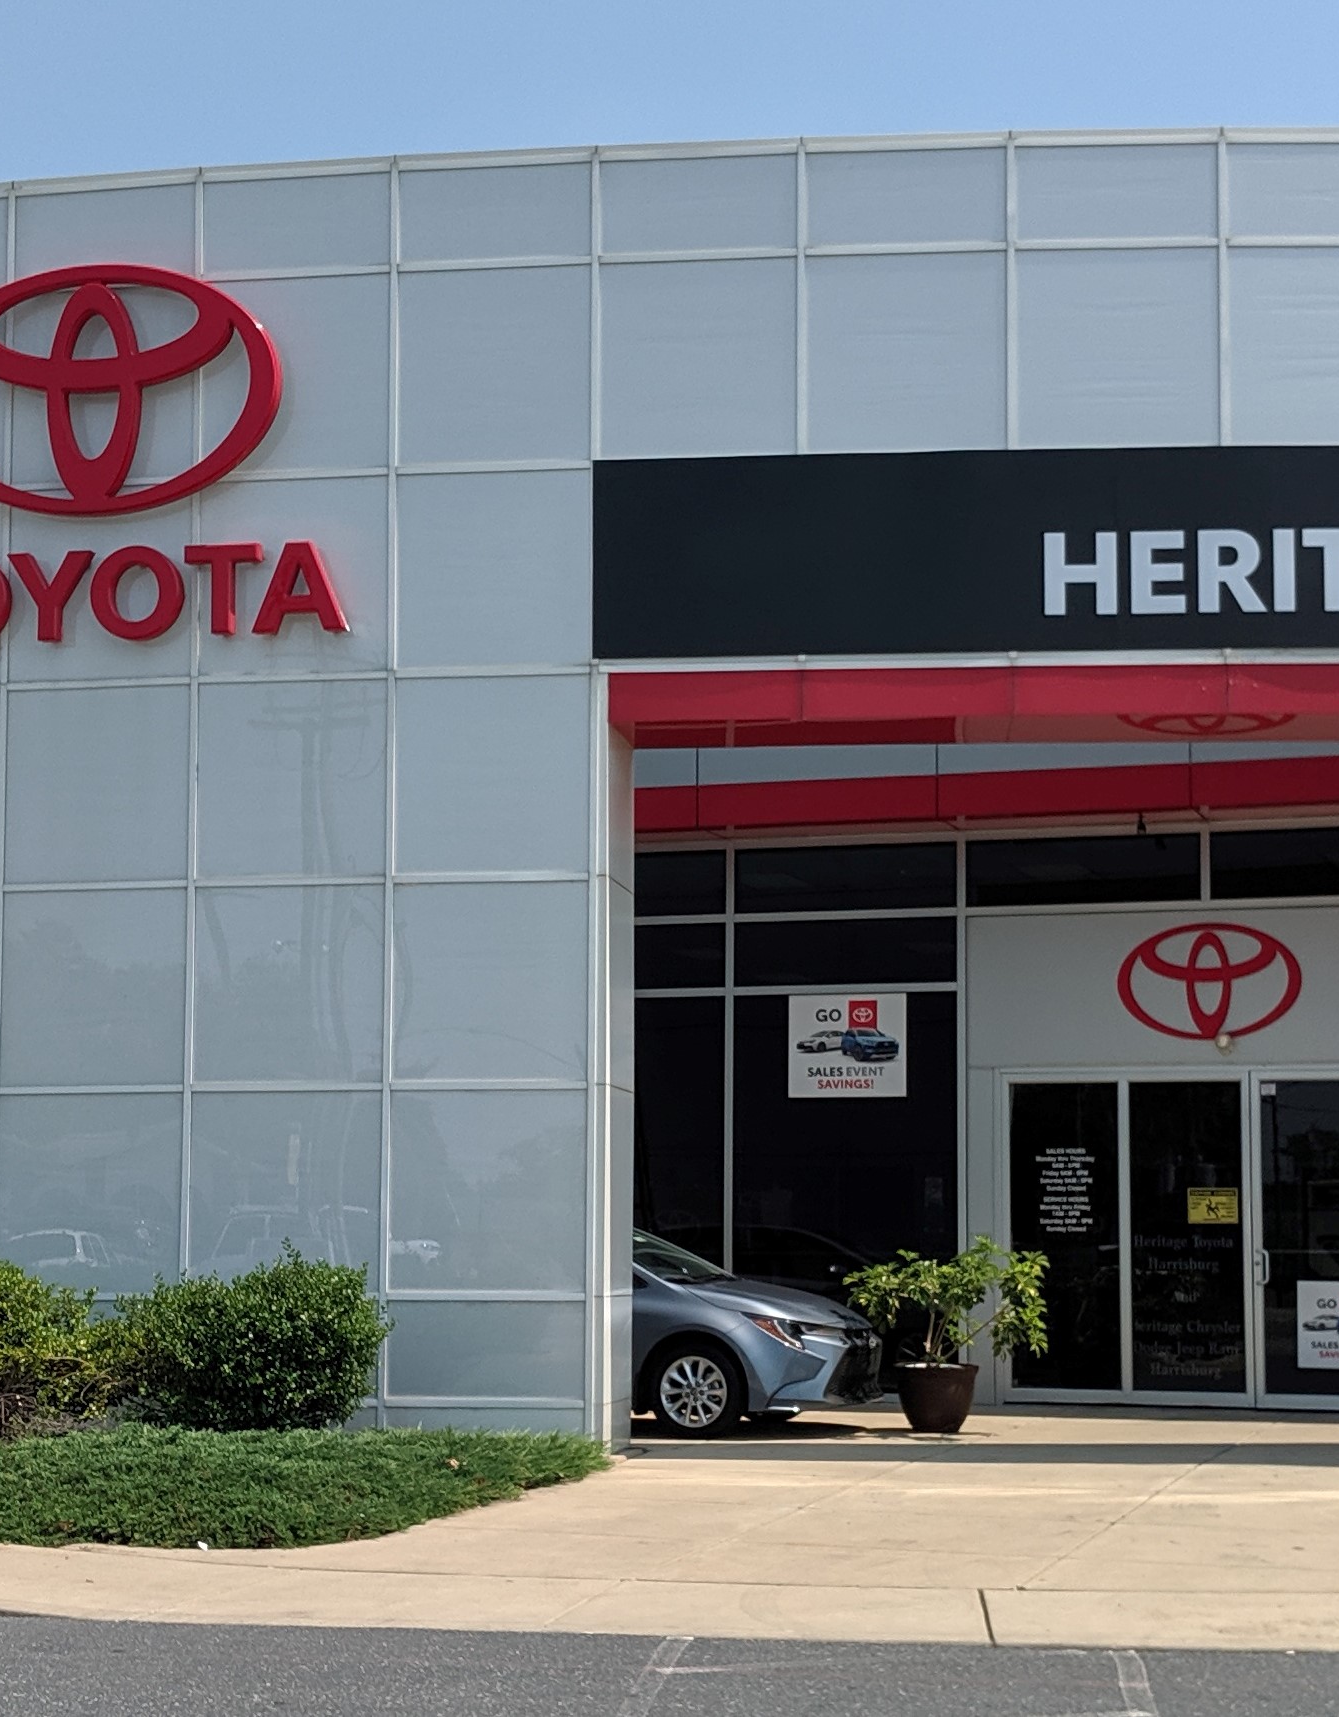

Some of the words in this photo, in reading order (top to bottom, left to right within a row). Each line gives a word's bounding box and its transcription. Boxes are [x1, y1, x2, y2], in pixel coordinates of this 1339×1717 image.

[815, 1009, 842, 1022] GO
[807, 1066, 843, 1077] SALES
[845, 1066, 885, 1077] EVENT
[817, 1079, 874, 1090] SAVINGS!
[1133, 1234, 1188, 1250] Heritage
[1191, 1234, 1234, 1250] Toyota
[1148, 1256, 1220, 1273] Harrisburg
[1316, 1298, 1337, 1309] GO
[1311, 1341, 1339, 1350] SALES
